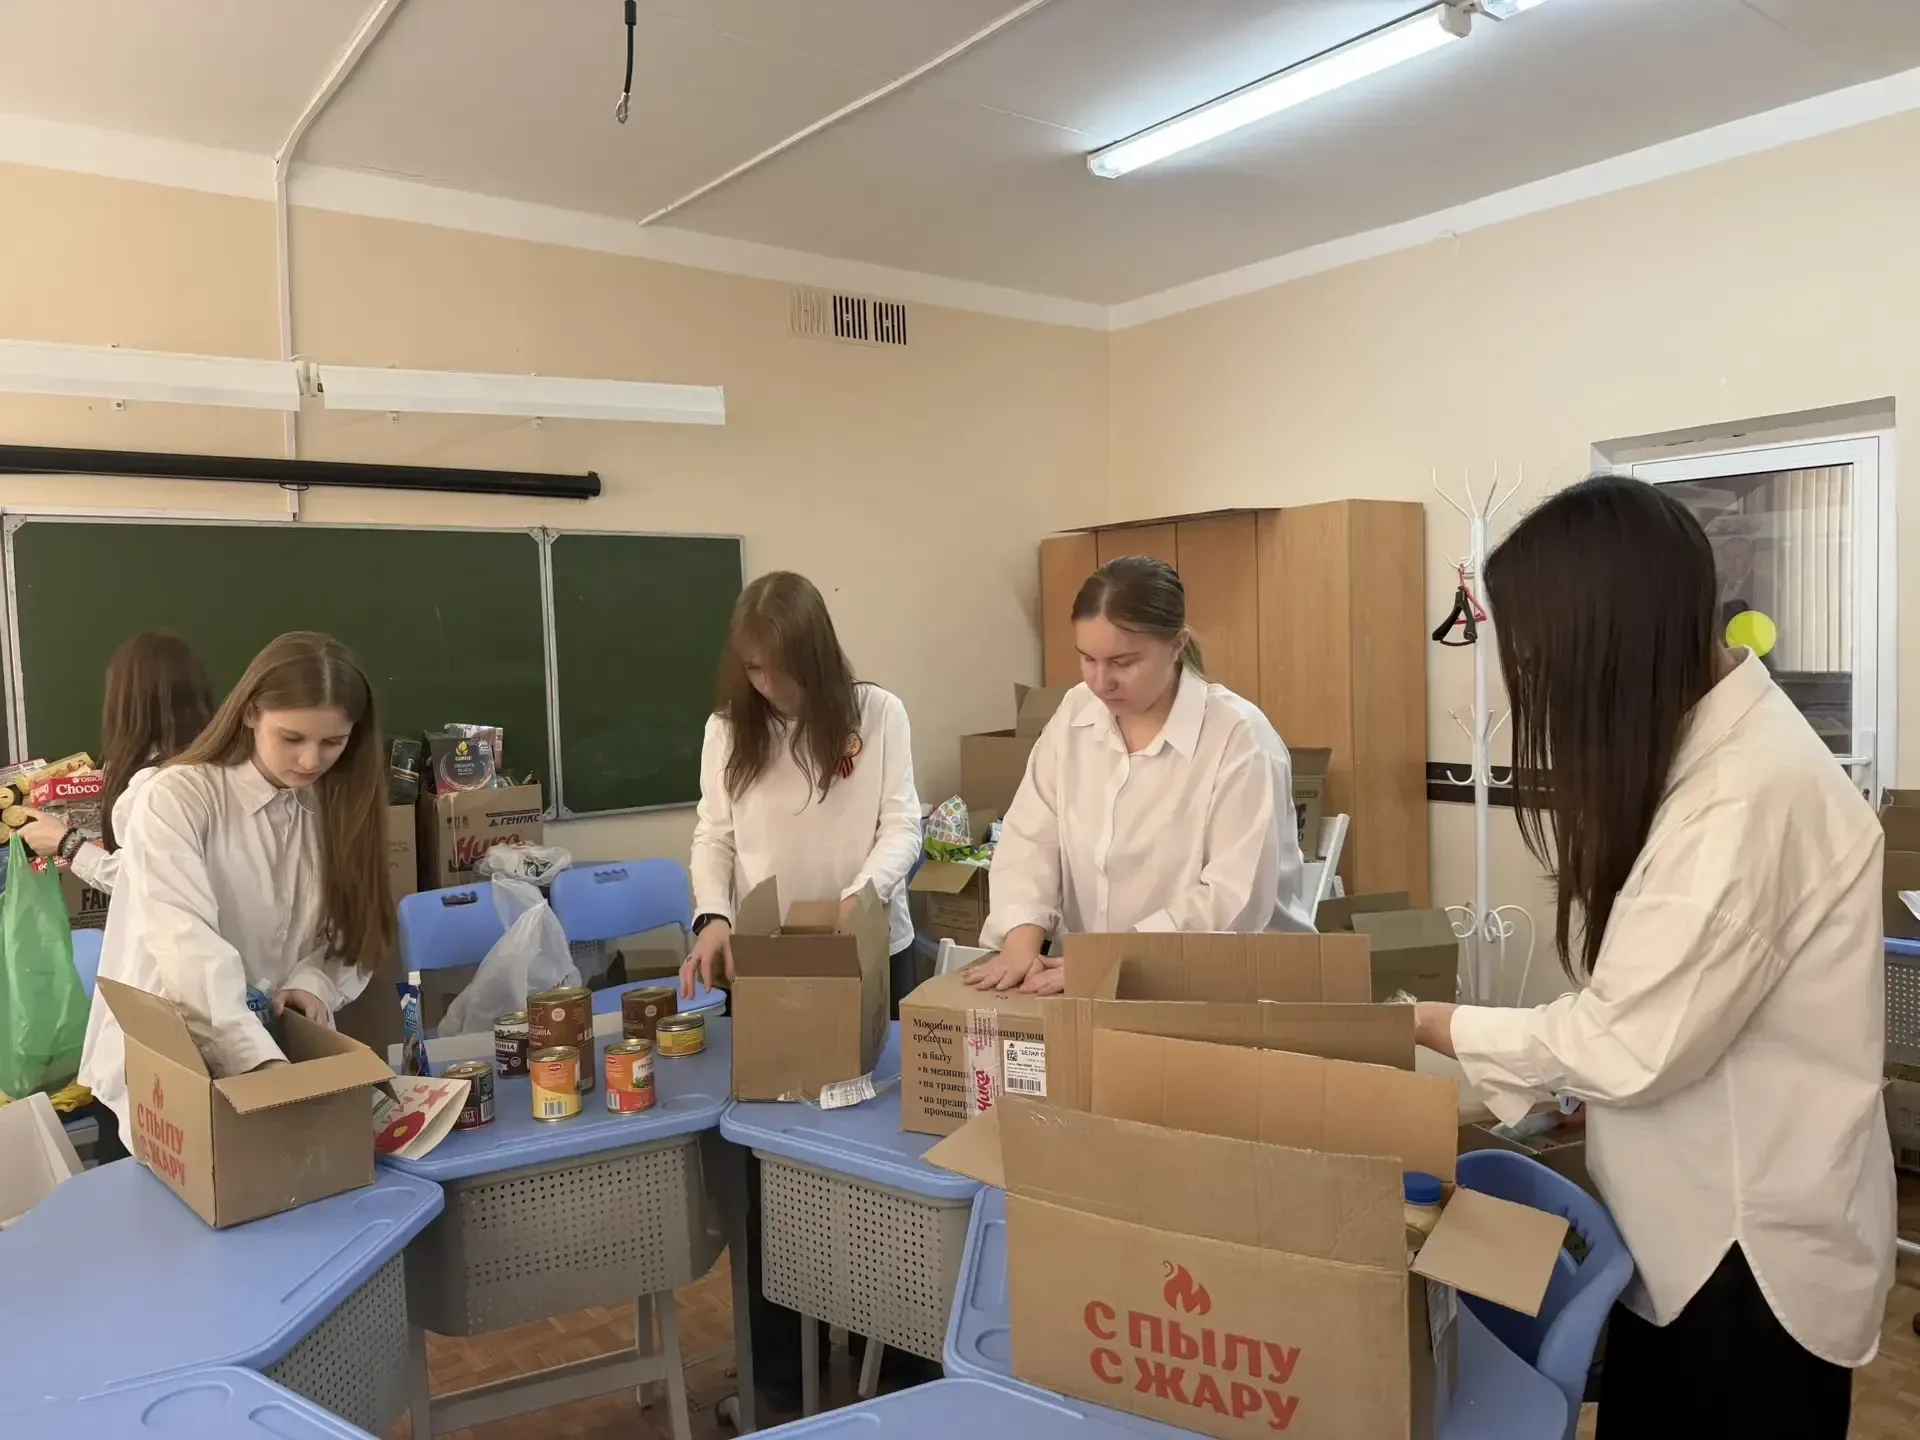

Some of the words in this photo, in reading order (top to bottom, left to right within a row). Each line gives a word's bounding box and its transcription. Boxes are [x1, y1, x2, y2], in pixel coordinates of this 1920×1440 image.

[500, 813, 541, 826] ГЕНИКС
[912, 1032, 953, 1045] средства
[930, 1050, 953, 1064] быту
[923, 1080, 934, 1088] на
[923, 1096, 934, 1104] на
[137, 1101, 144, 1129] С
[145, 1107, 184, 1155] ПЫЛУ
[148, 1139, 185, 1187] ЖАРУ
[1083, 1300, 1118, 1340] С
[1128, 1308, 1303, 1385] ПЫЛУ
[1090, 1346, 1124, 1385] С
[1134, 1355, 1301, 1431] ЖАРУ
